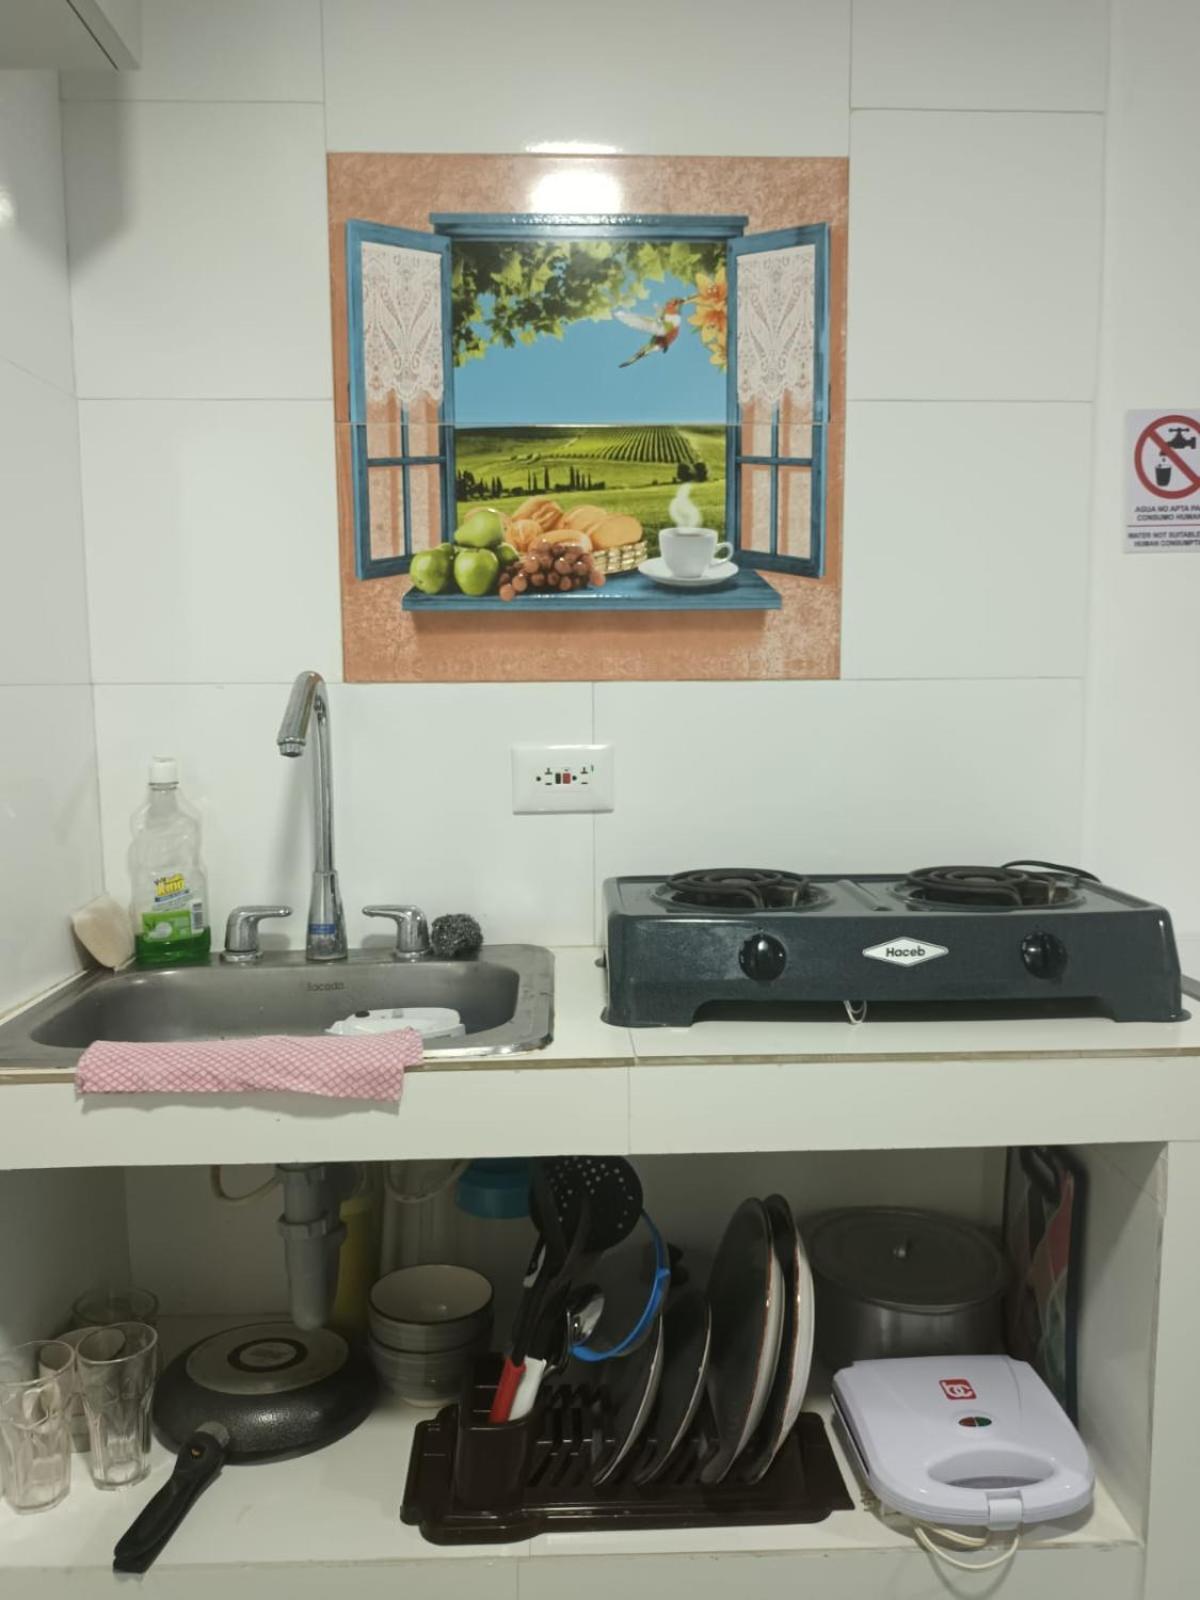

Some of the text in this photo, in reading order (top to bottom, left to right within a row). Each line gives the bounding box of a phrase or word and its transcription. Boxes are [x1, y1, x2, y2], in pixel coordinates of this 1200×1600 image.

[1170, 504, 1189, 512] APTA
[1136, 514, 1175, 522] CONSUMO
[1152, 531, 1168, 539] NOT
[885, 945, 926, 957] Haceb
